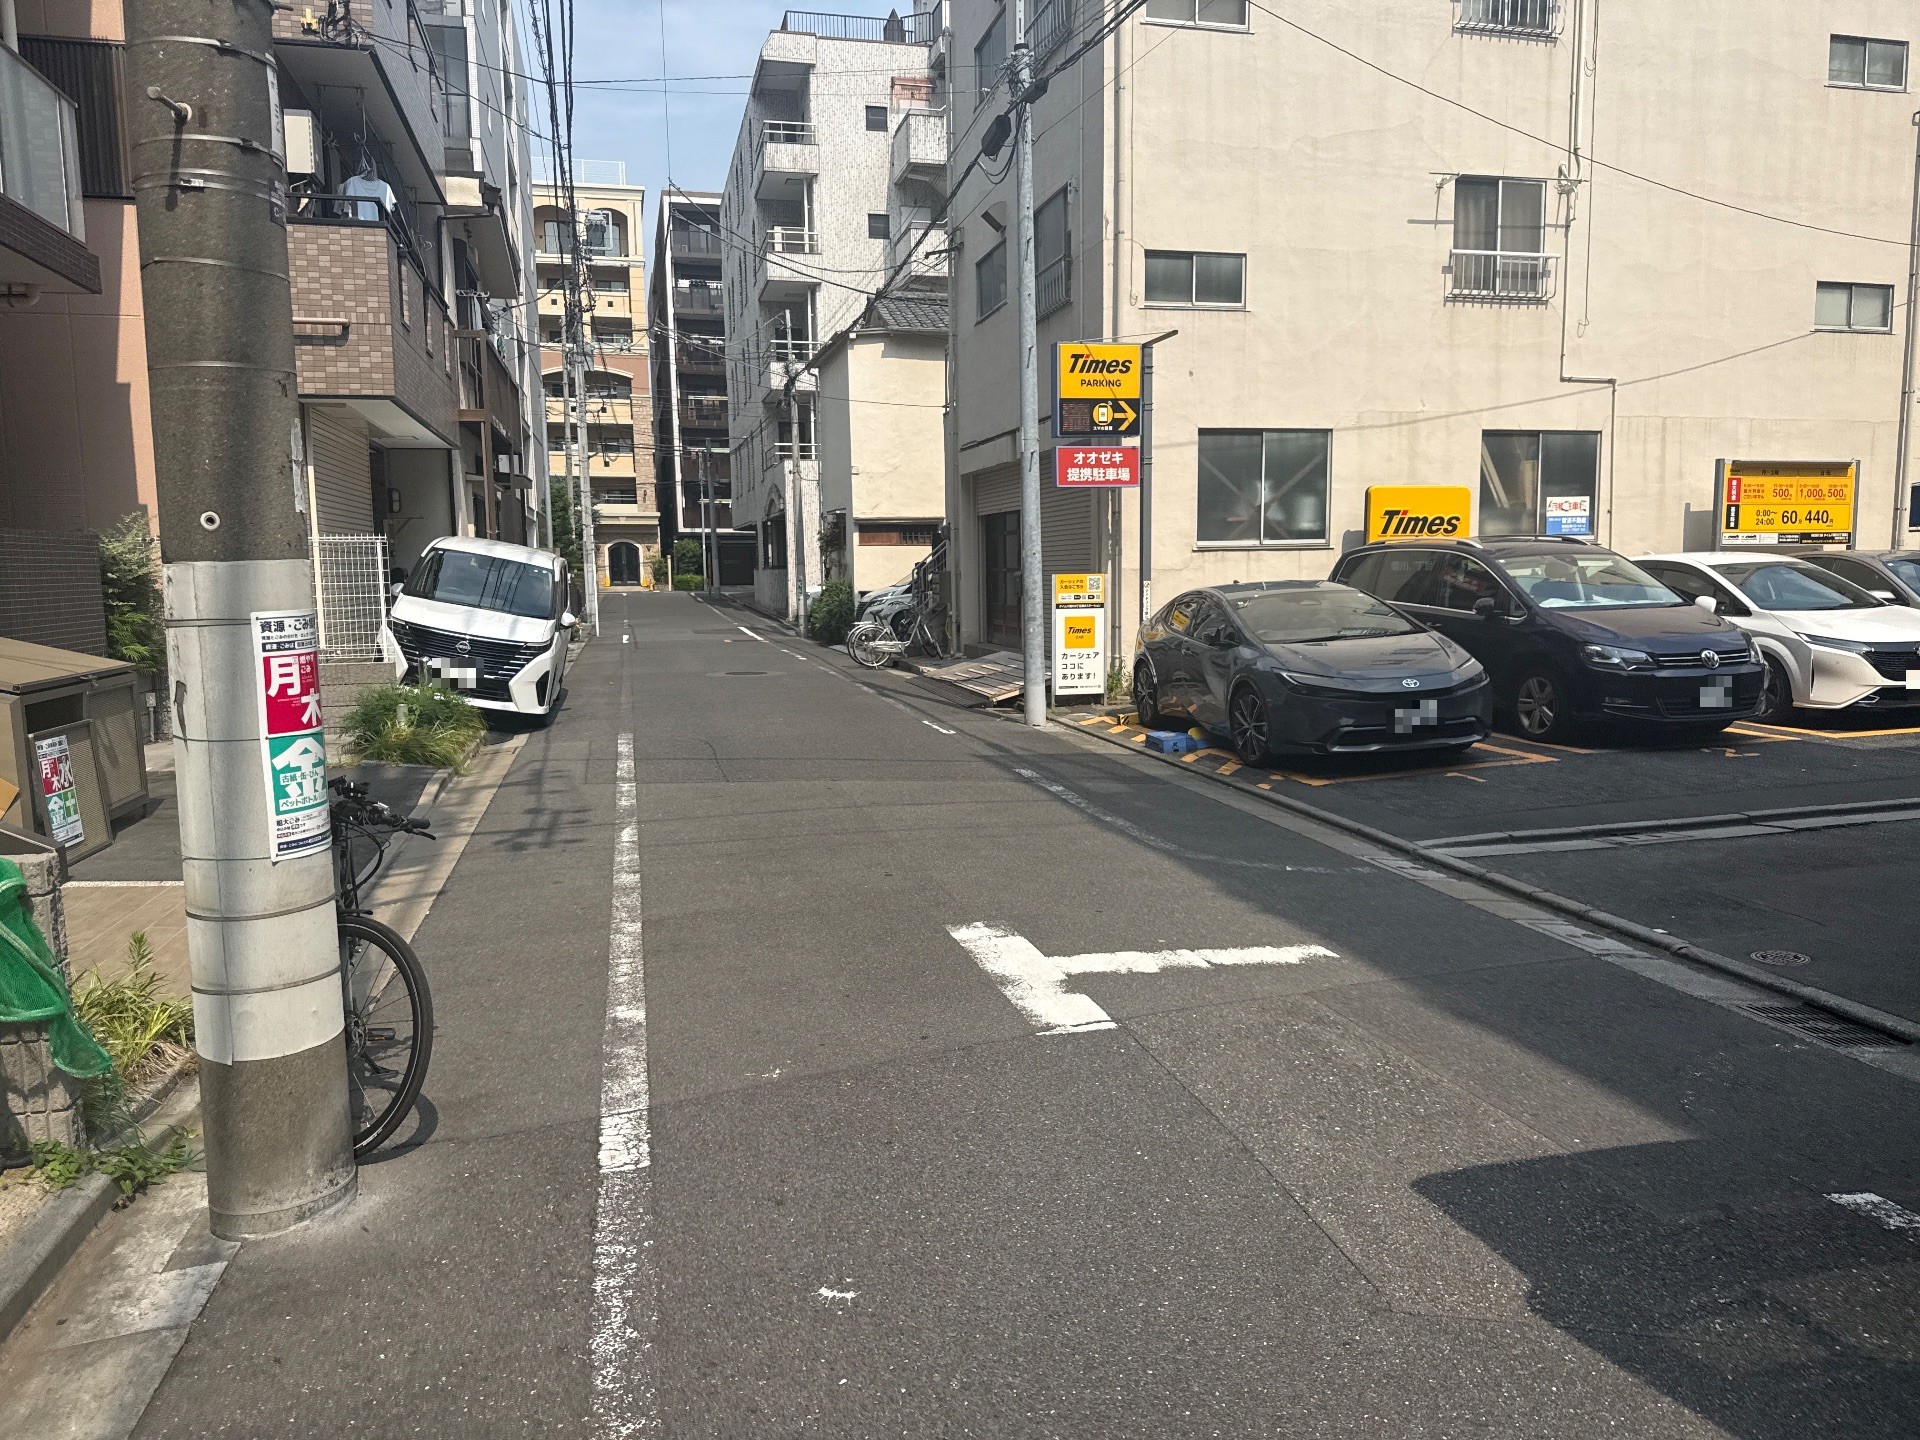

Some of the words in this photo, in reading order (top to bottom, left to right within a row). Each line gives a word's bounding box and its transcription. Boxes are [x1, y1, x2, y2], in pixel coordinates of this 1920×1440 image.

[1069, 354, 1132, 374] Times
[1081, 379, 1122, 388] PARKING
[1074, 451, 1124, 464] オオゼキ
[1067, 468, 1130, 482] 提携駐車場
[1380, 510, 1461, 534] Times
[1061, 652, 1099, 660] カーシェア
[267, 655, 301, 697] 月
[301, 665, 311, 674] ごみ
[301, 688, 322, 726] 木
[41, 761, 51, 778] 月
[59, 756, 73, 787] 水
[272, 736, 326, 802] 金
[281, 796, 318, 808] ペットボトル
